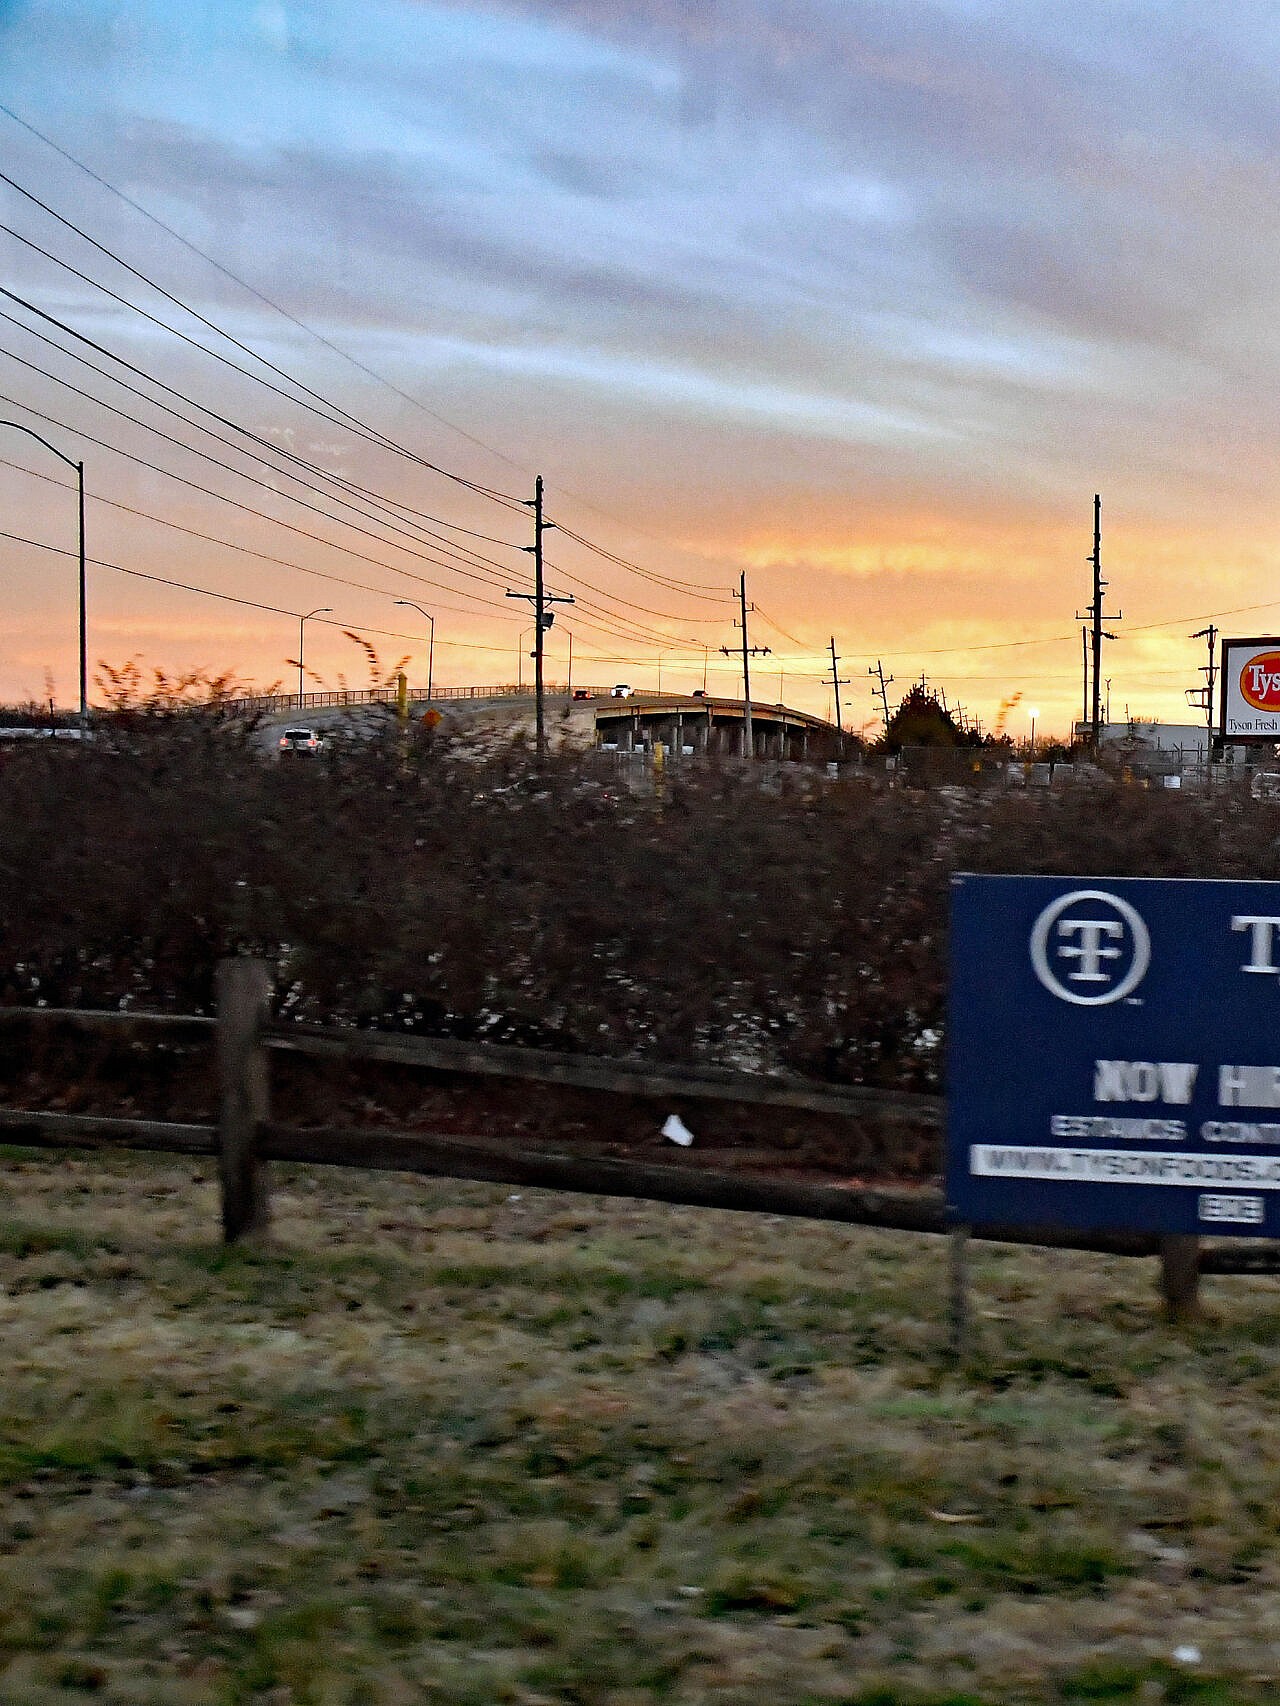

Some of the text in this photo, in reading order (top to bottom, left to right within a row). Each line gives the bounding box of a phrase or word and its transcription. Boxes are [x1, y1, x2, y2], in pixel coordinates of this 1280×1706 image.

[1229, 719, 1252, 733] Tyson
[1255, 719, 1278, 730] Fresh
[1095, 1059, 1199, 1104] NOW
